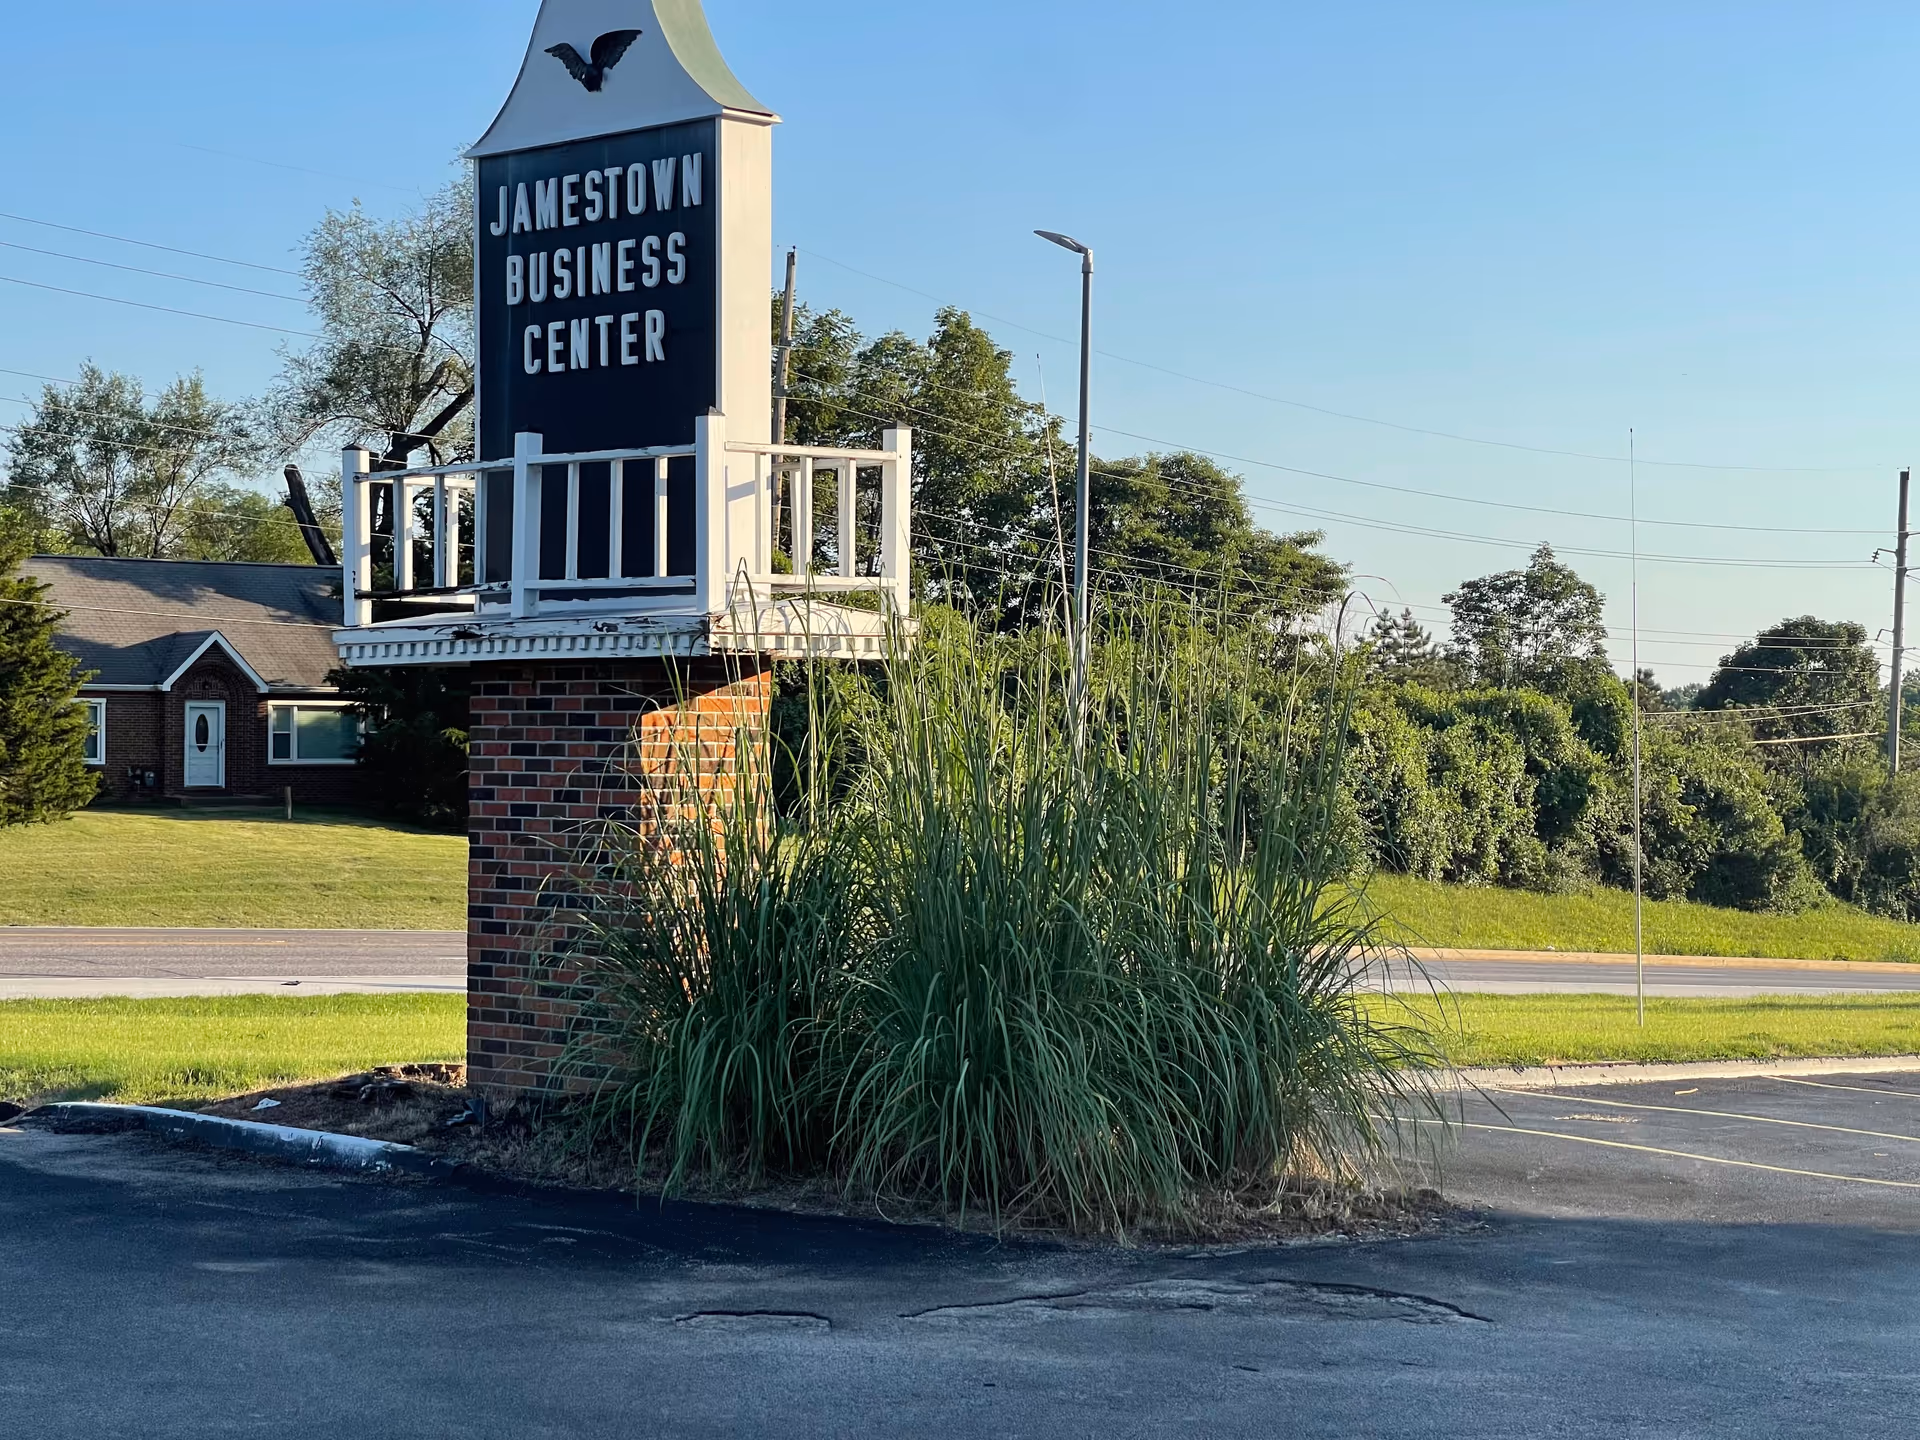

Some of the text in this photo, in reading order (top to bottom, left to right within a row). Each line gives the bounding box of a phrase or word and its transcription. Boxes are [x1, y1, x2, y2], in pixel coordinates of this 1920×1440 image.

[490, 152, 702, 236] JAMESTOWN
[506, 232, 686, 305] BUSINESS
[524, 309, 665, 375] CENTER
